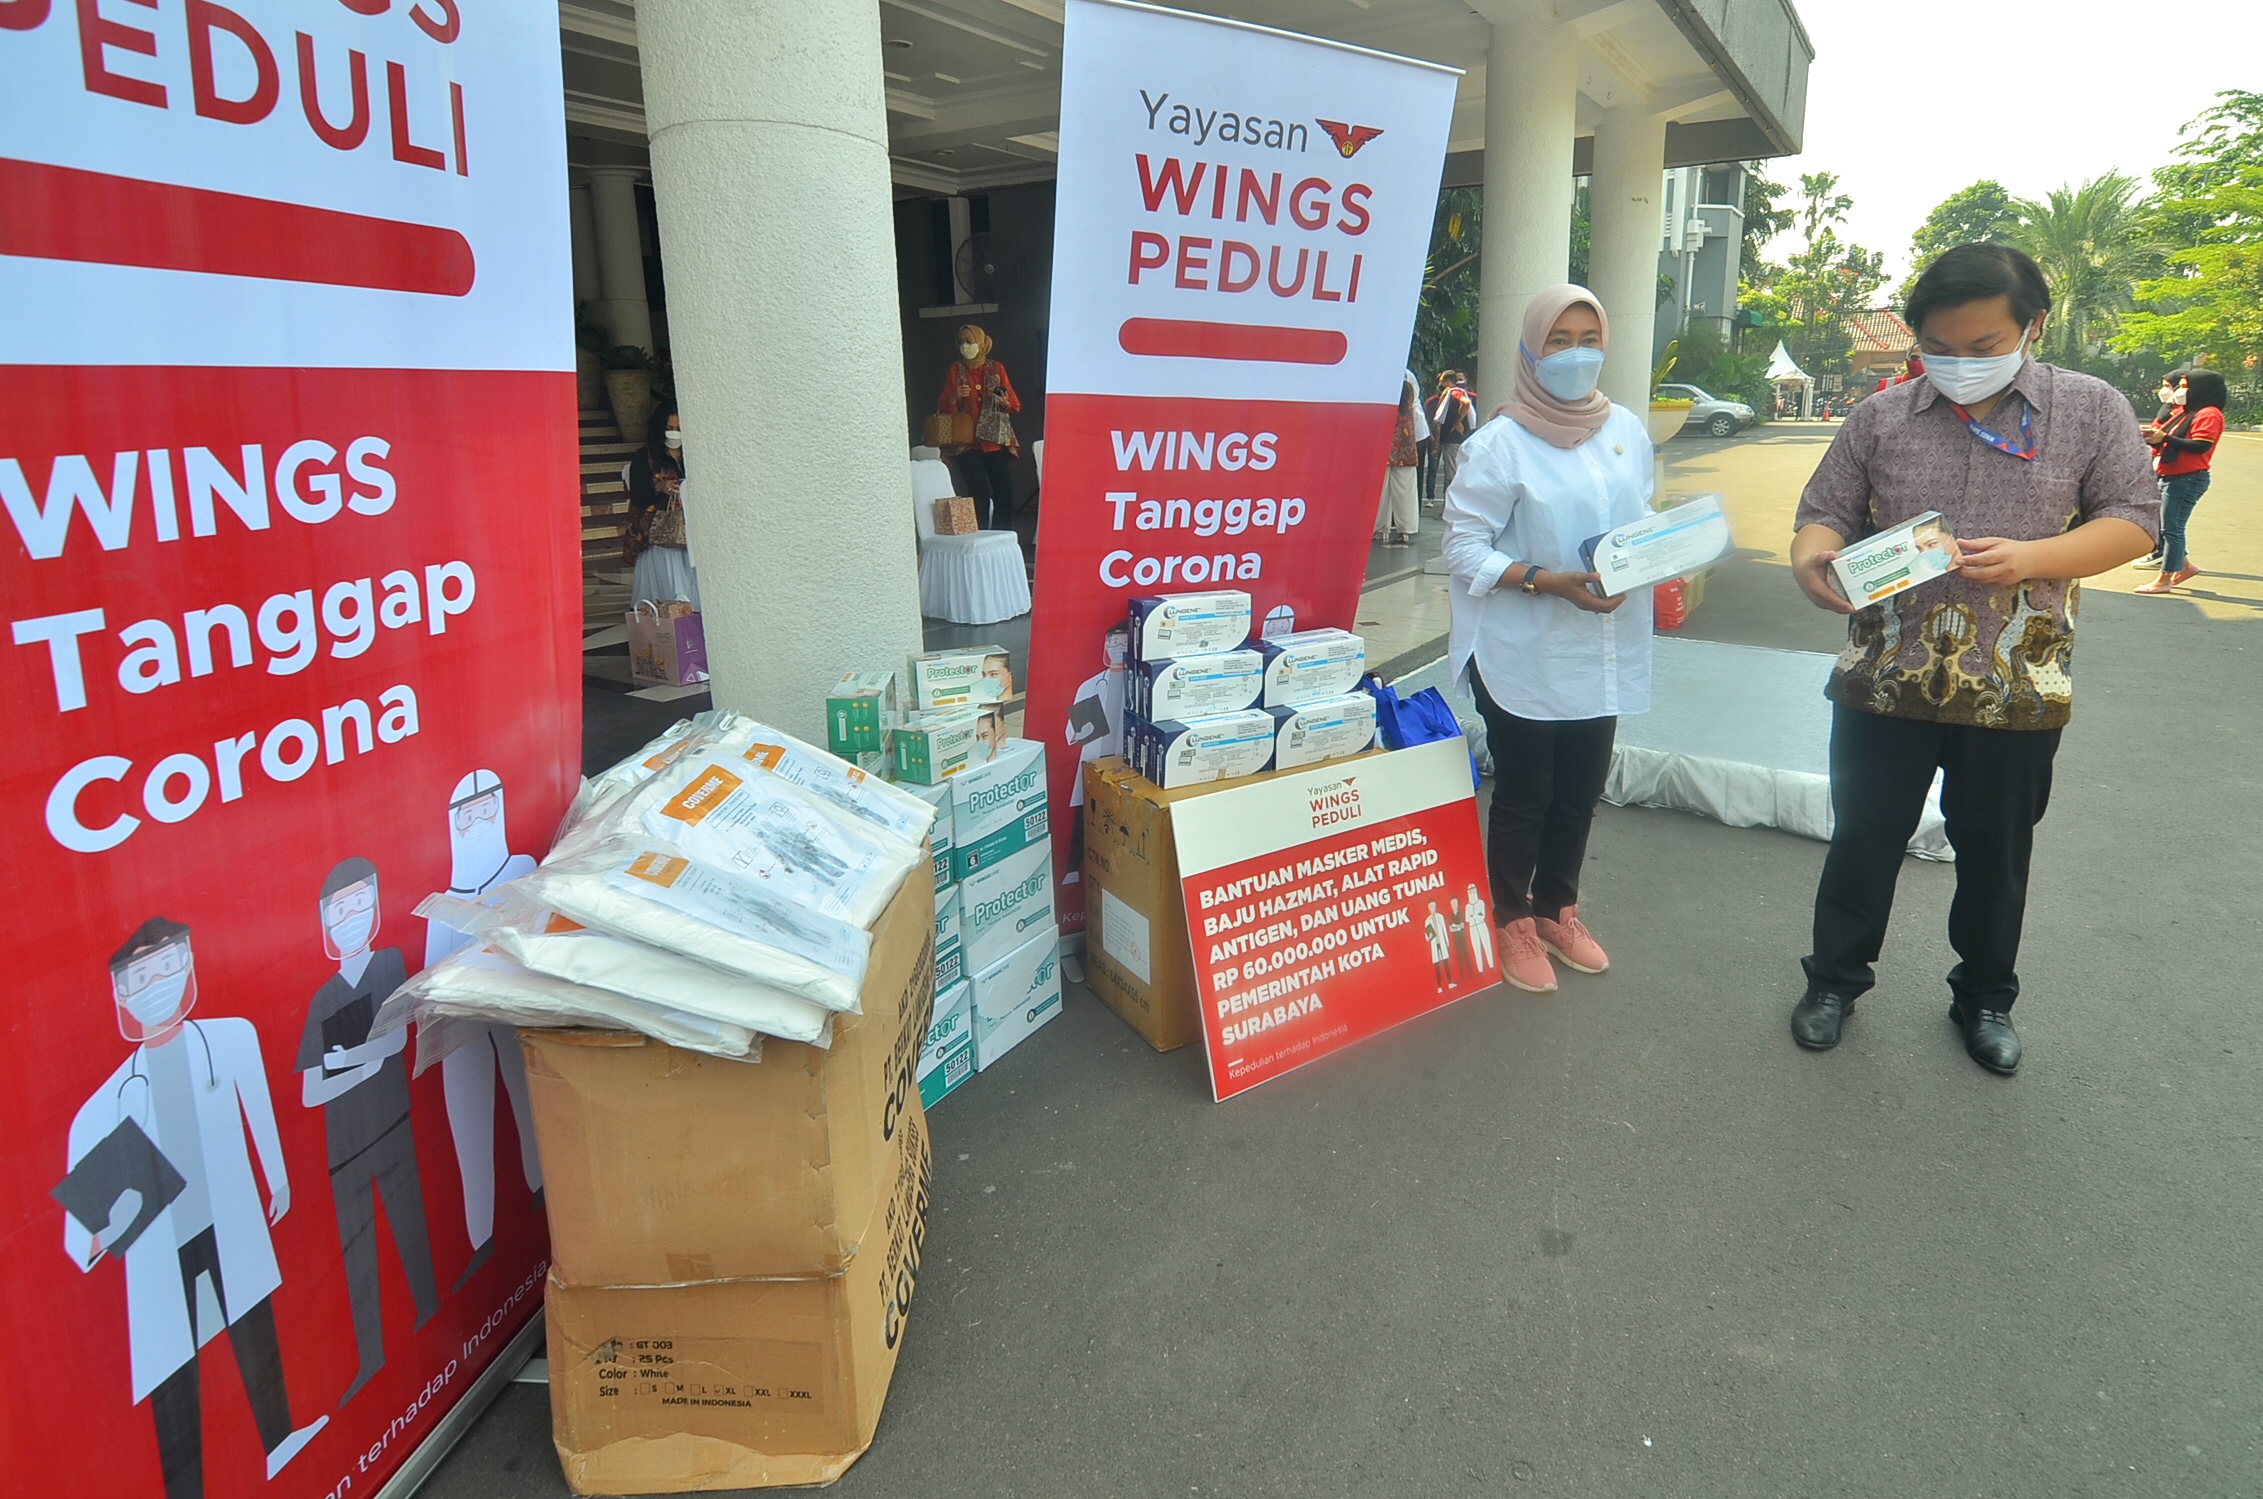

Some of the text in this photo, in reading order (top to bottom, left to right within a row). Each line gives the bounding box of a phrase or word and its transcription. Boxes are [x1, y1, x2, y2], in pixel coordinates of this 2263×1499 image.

[1139, 89, 1308, 152] Yayasan
[1135, 153, 1373, 236] WINGS
[1128, 231, 1363, 303] PEDULI
[1110, 430, 1278, 471] WINGS
[0, 436, 397, 560] WINGS
[1105, 492, 1307, 536] Tanggap
[1100, 550, 1262, 587] Corona
[1847, 541, 1909, 575] Protector
[11, 560, 476, 713] Tanggap
[927, 665, 978, 679] Protector
[937, 729, 973, 749] Protector
[45, 684, 419, 853] Corona
[1307, 782, 1342, 796] Yayasan
[682, 775, 724, 810] COVERME
[969, 771, 1037, 813] Protector
[1309, 789, 1360, 812] WINGS
[1025, 811, 1046, 828] 50122
[1311, 804, 1362, 829] PEDULI
[970, 856, 976, 866] 6
[1200, 828, 1428, 909] BANTUAN MASKER MEDIS,
[974, 874, 1045, 926] Protector
[1203, 849, 1438, 936] BAJU HAZMAT, ALAT RAPID
[1209, 871, 1445, 964] ANTIGEN, DAN UANG TUNAI
[935, 955, 959, 977] 50122
[1213, 907, 1410, 991] RP 60.000.000 UNTUK
[1217, 942, 1385, 1018] PEMERINTAH KOTA
[1221, 993, 1323, 1046] SURABAYA
[945, 1050, 969, 1074] 50122
[1229, 1023, 1348, 1080] Kepedulian terhadap Indonesia
[636, 1341, 673, 1350] GT 003
[638, 1354, 674, 1364] 25 Pcs
[356, 1358, 458, 1474] terhadap
[462, 1260, 547, 1360] Indonesia
[598, 1368, 669, 1379] Color White
[599, 1384, 812, 1399] Size S M L XL XXL XXXL
[662, 1397, 689, 1405] MADE
[701, 1399, 752, 1407] INDONESIA
